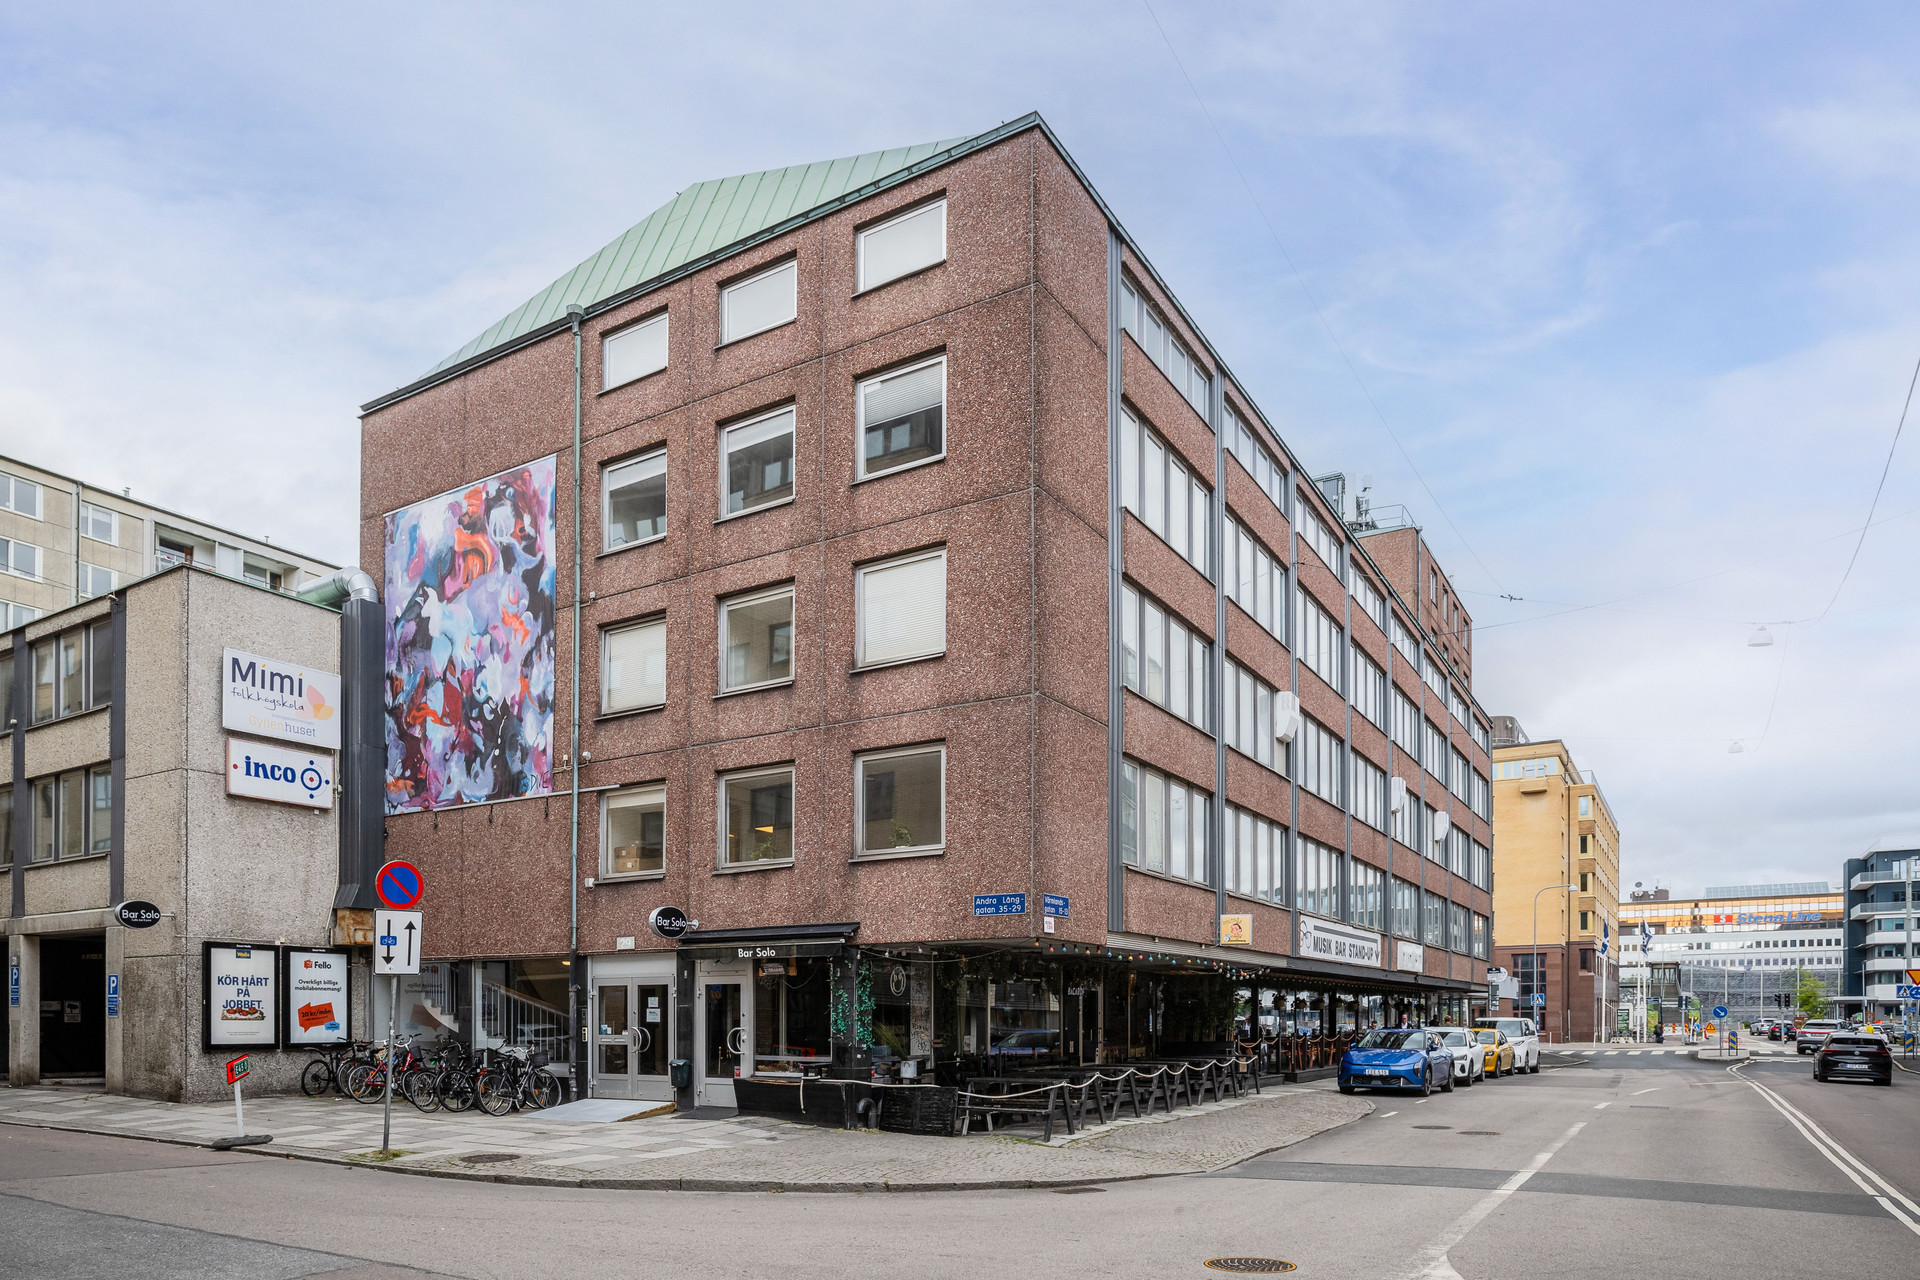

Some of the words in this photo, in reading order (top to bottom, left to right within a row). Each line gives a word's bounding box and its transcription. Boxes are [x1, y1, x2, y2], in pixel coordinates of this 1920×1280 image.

[232, 657, 303, 697] Mimi
[249, 714, 316, 737] Gyllenhuset
[245, 755, 296, 783] inco
[121, 910, 139, 919] Bar
[140, 910, 160, 919] Solo
[975, 907, 996, 915] gatan
[998, 904, 1022, 913] 35-29
[1044, 906, 1056, 914] gatan
[657, 916, 670, 926] Bar
[671, 917, 686, 927] Solo
[1736, 913, 1784, 924] Stena
[1785, 911, 1822, 922] Line
[619, 938, 631, 948] 29
[1313, 936, 1332, 955] MUSIK
[1335, 941, 1346, 957] BAR
[1348, 943, 1373, 961] STAND-UP
[737, 948, 753, 958] Bar
[756, 947, 776, 957] Solo
[314, 961, 332, 969] Fello
[13, 968, 19, 985] P
[217, 974, 239, 986] KÖR
[241, 975, 269, 987] HÅRT
[110, 976, 117, 994] P
[236, 986, 251, 997] PÅ
[222, 999, 264, 1010] JOBBET.
